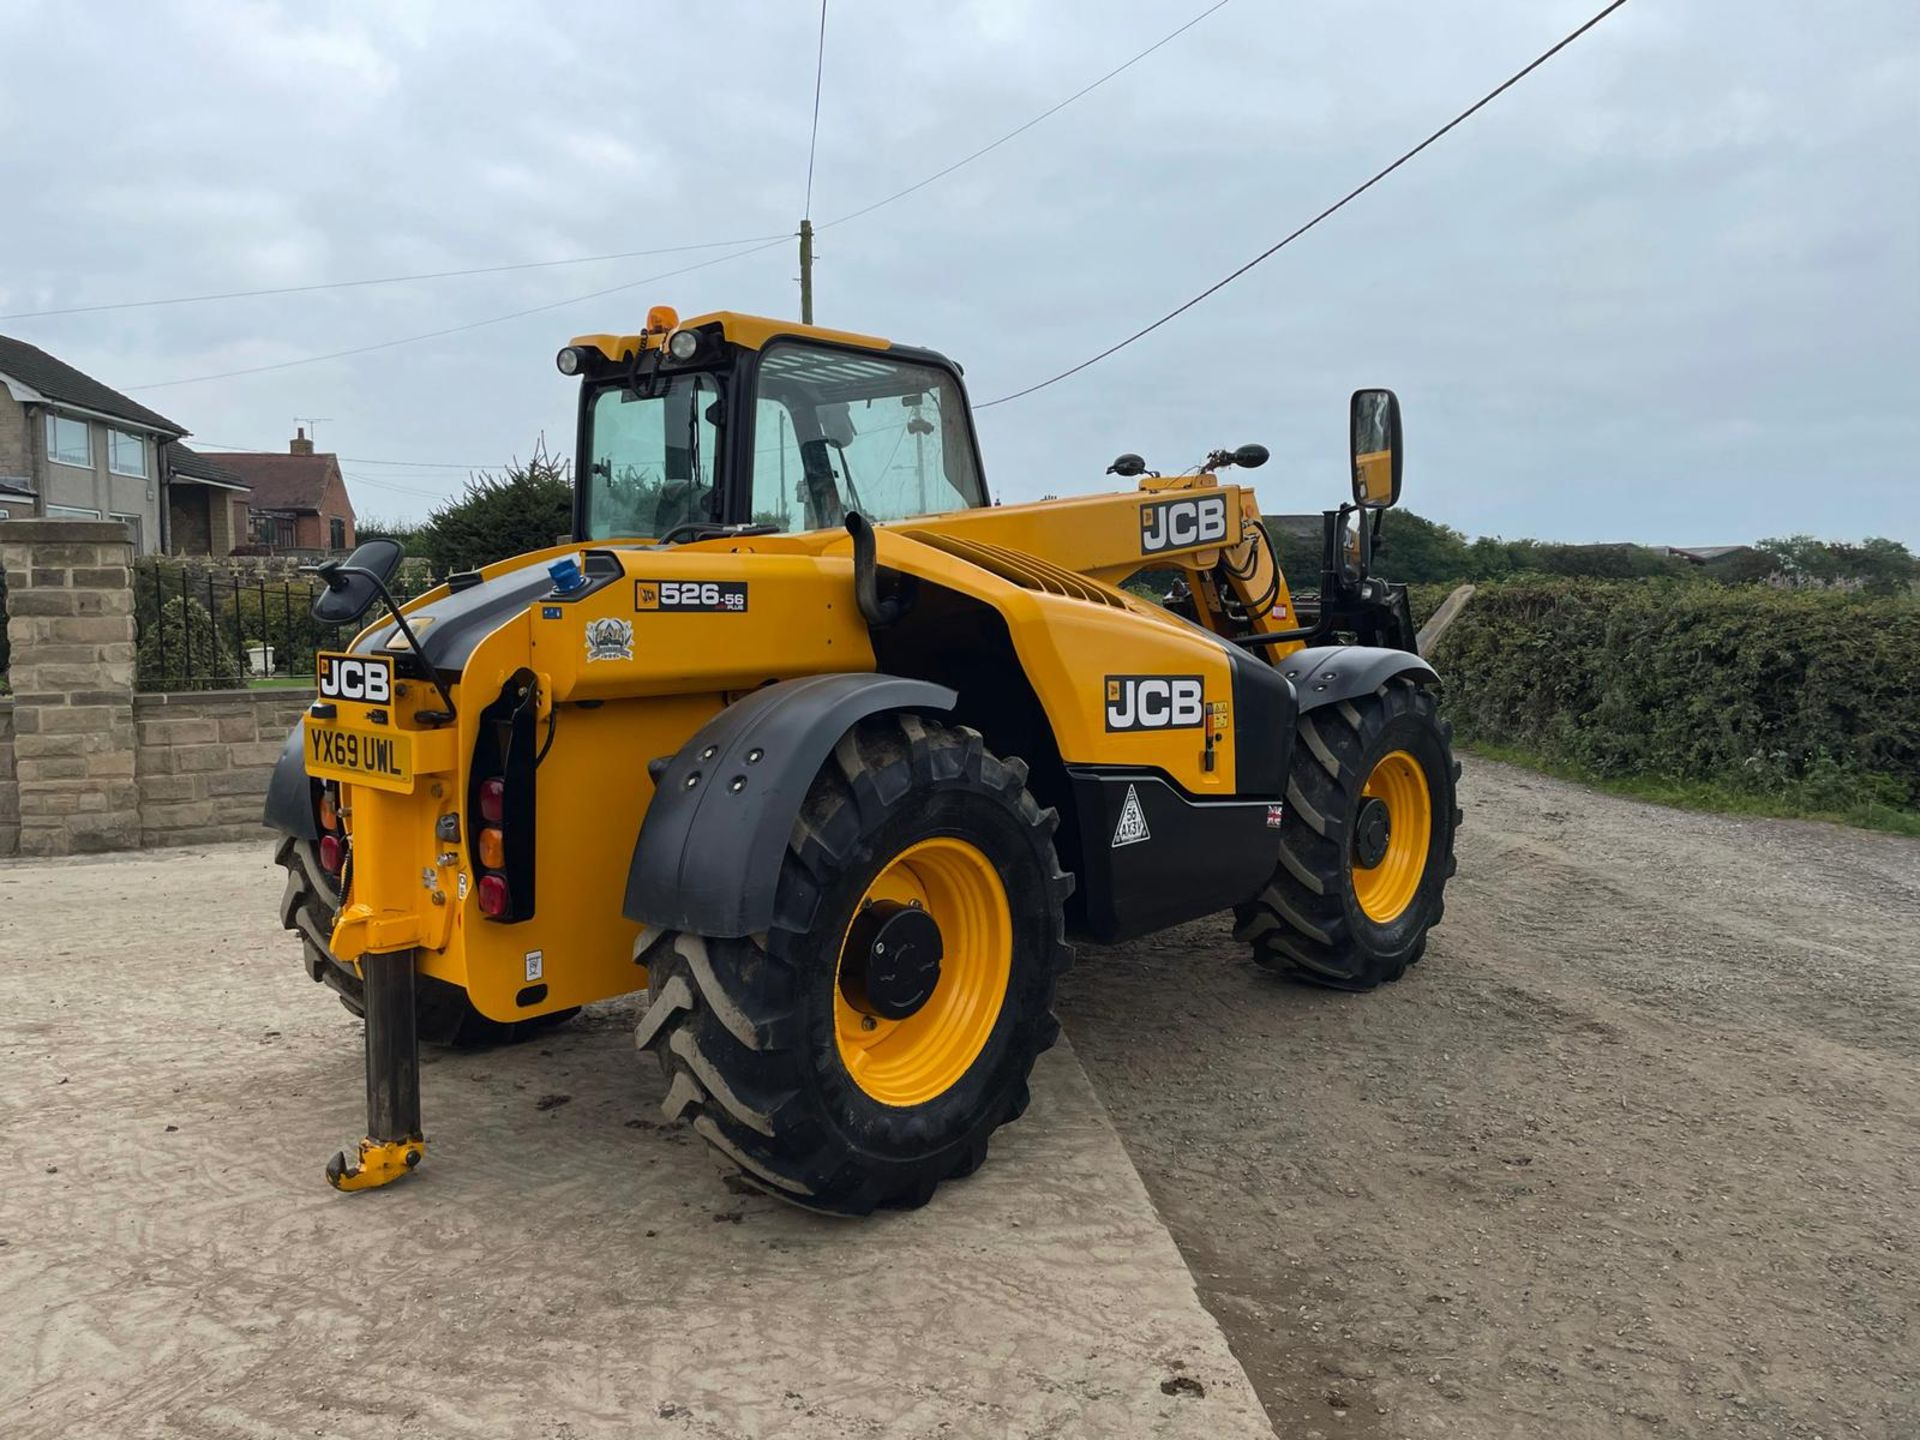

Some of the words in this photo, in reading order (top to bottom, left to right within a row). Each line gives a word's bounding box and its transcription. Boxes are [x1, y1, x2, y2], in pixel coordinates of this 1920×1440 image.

[1143, 499, 1225, 550] JCB
[321, 660, 389, 701] JCB
[1108, 680, 1202, 728] JCB
[311, 728, 358, 767] YX69
[363, 736, 402, 775] UWL
